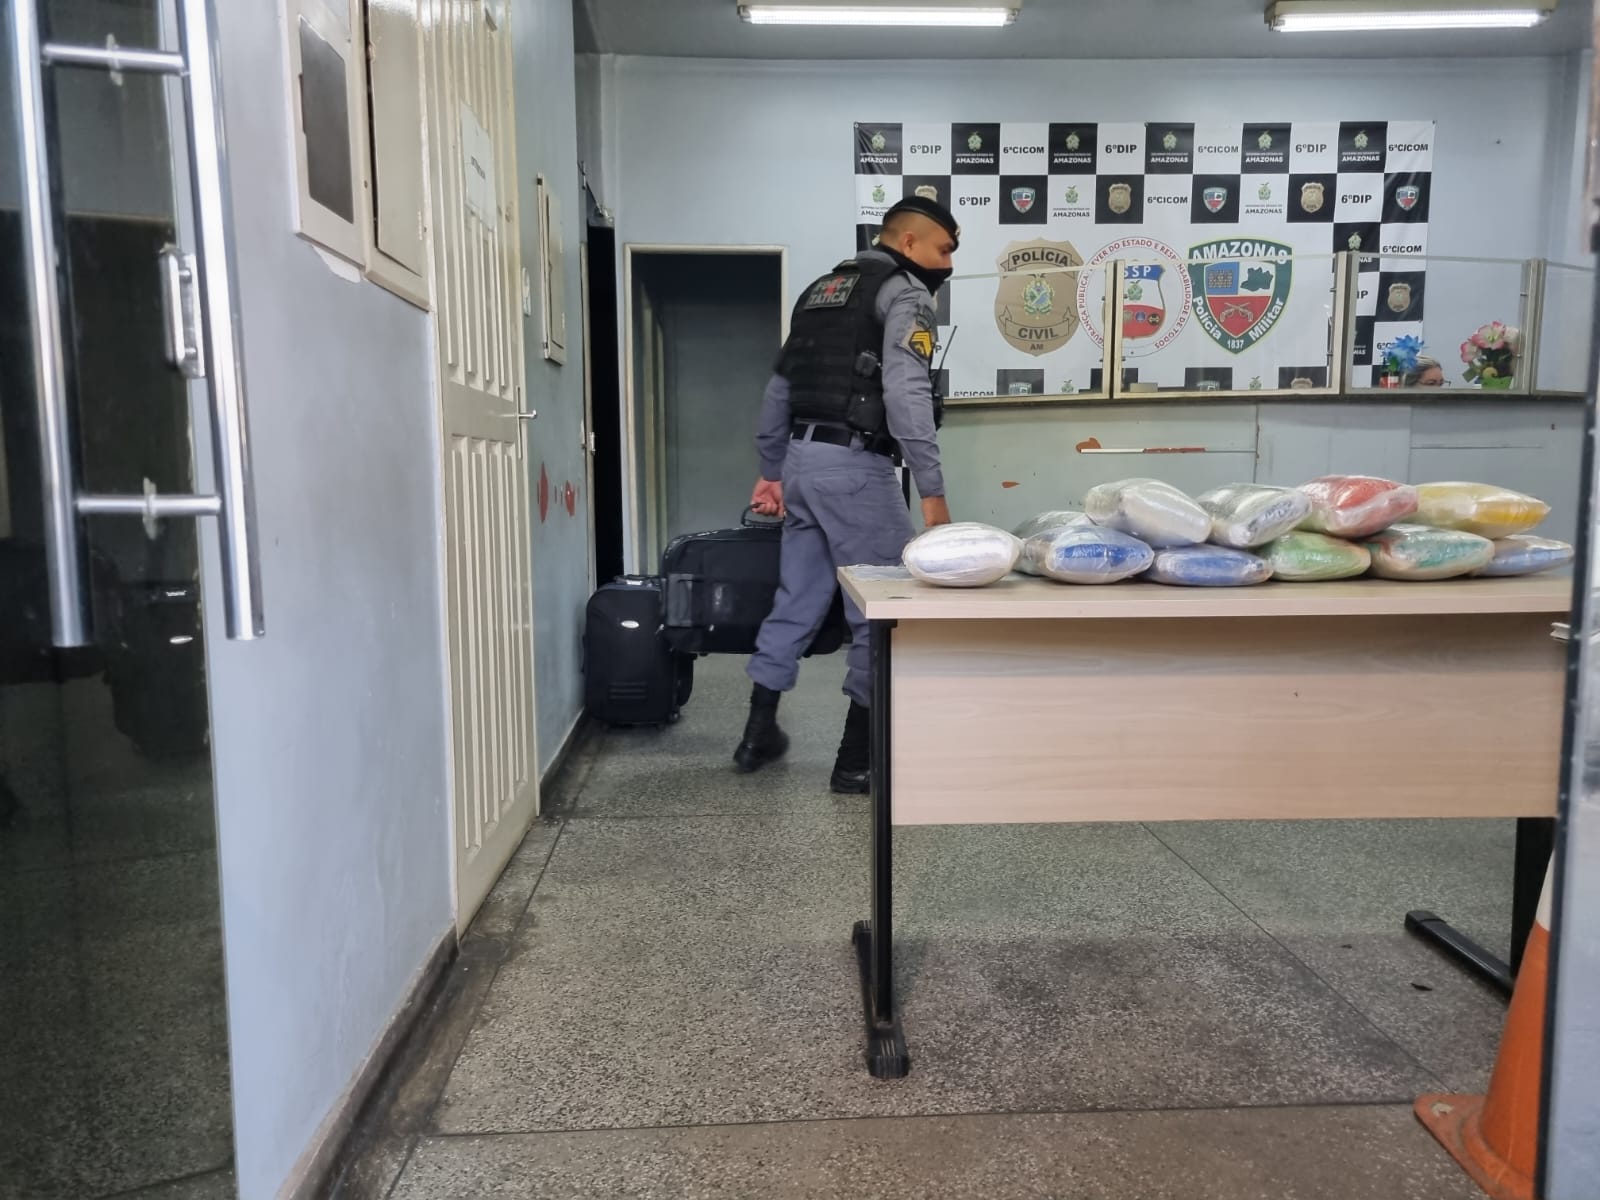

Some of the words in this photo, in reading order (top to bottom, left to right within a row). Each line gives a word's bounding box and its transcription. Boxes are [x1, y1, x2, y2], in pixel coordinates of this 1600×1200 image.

[860, 156, 898, 164] AMAZONAS
[1109, 243, 1121, 253] DO
[1122, 239, 1153, 248] ESTADO
[1012, 248, 1069, 267] POLÍCIA
[1192, 241, 1288, 265] AMAZONAS
[1160, 245, 1192, 317] RESPNSABILIDADE
[1178, 317, 1186, 328] DE
[1193, 296, 1223, 340] Polícia
[1248, 298, 1284, 341] Militar
[1018, 327, 1059, 339] CIVIL
[1154, 328, 1179, 349] TODOS
[1030, 343, 1044, 351] AM
[1227, 339, 1245, 349] 1837
